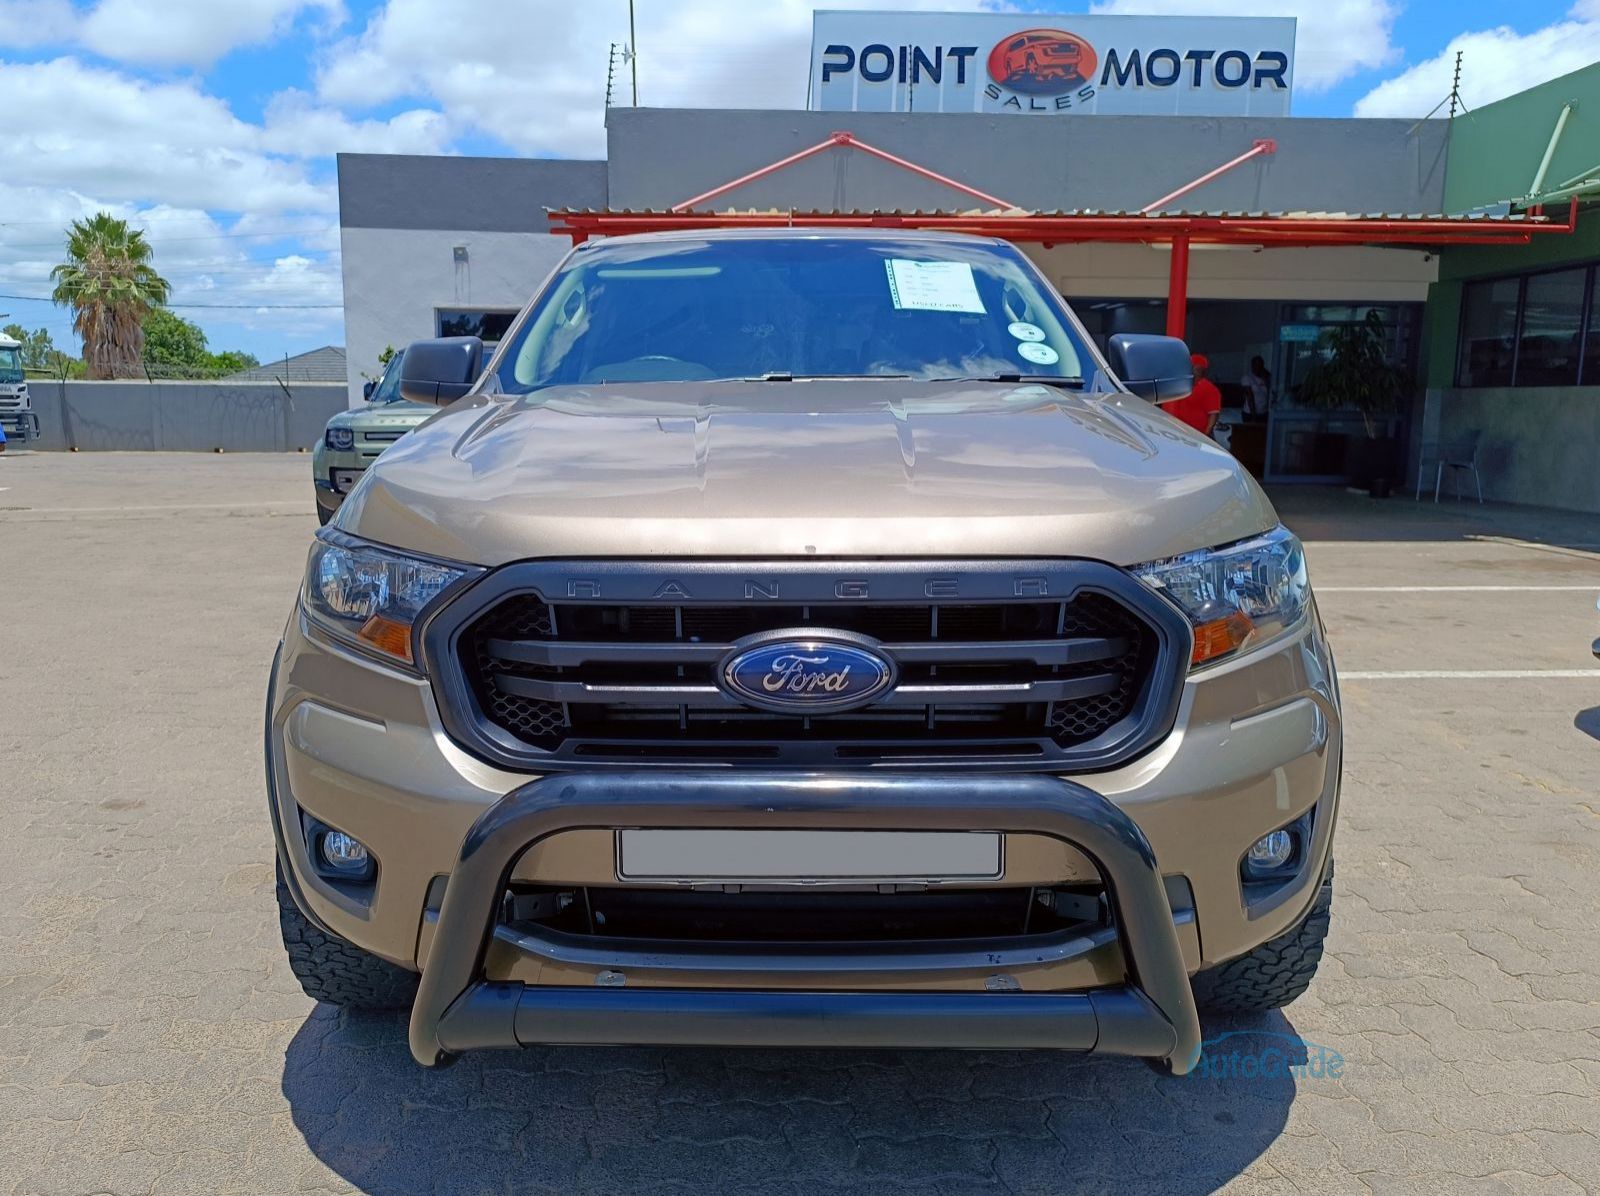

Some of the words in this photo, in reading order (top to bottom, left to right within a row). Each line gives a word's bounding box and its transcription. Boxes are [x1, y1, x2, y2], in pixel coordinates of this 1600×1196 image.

[821, 44, 978, 84] POINT
[1101, 48, 1288, 89] MOTOR
[984, 83, 1096, 110] SALES
[566, 578, 1048, 599] RANGER
[762, 654, 851, 693] Ford
